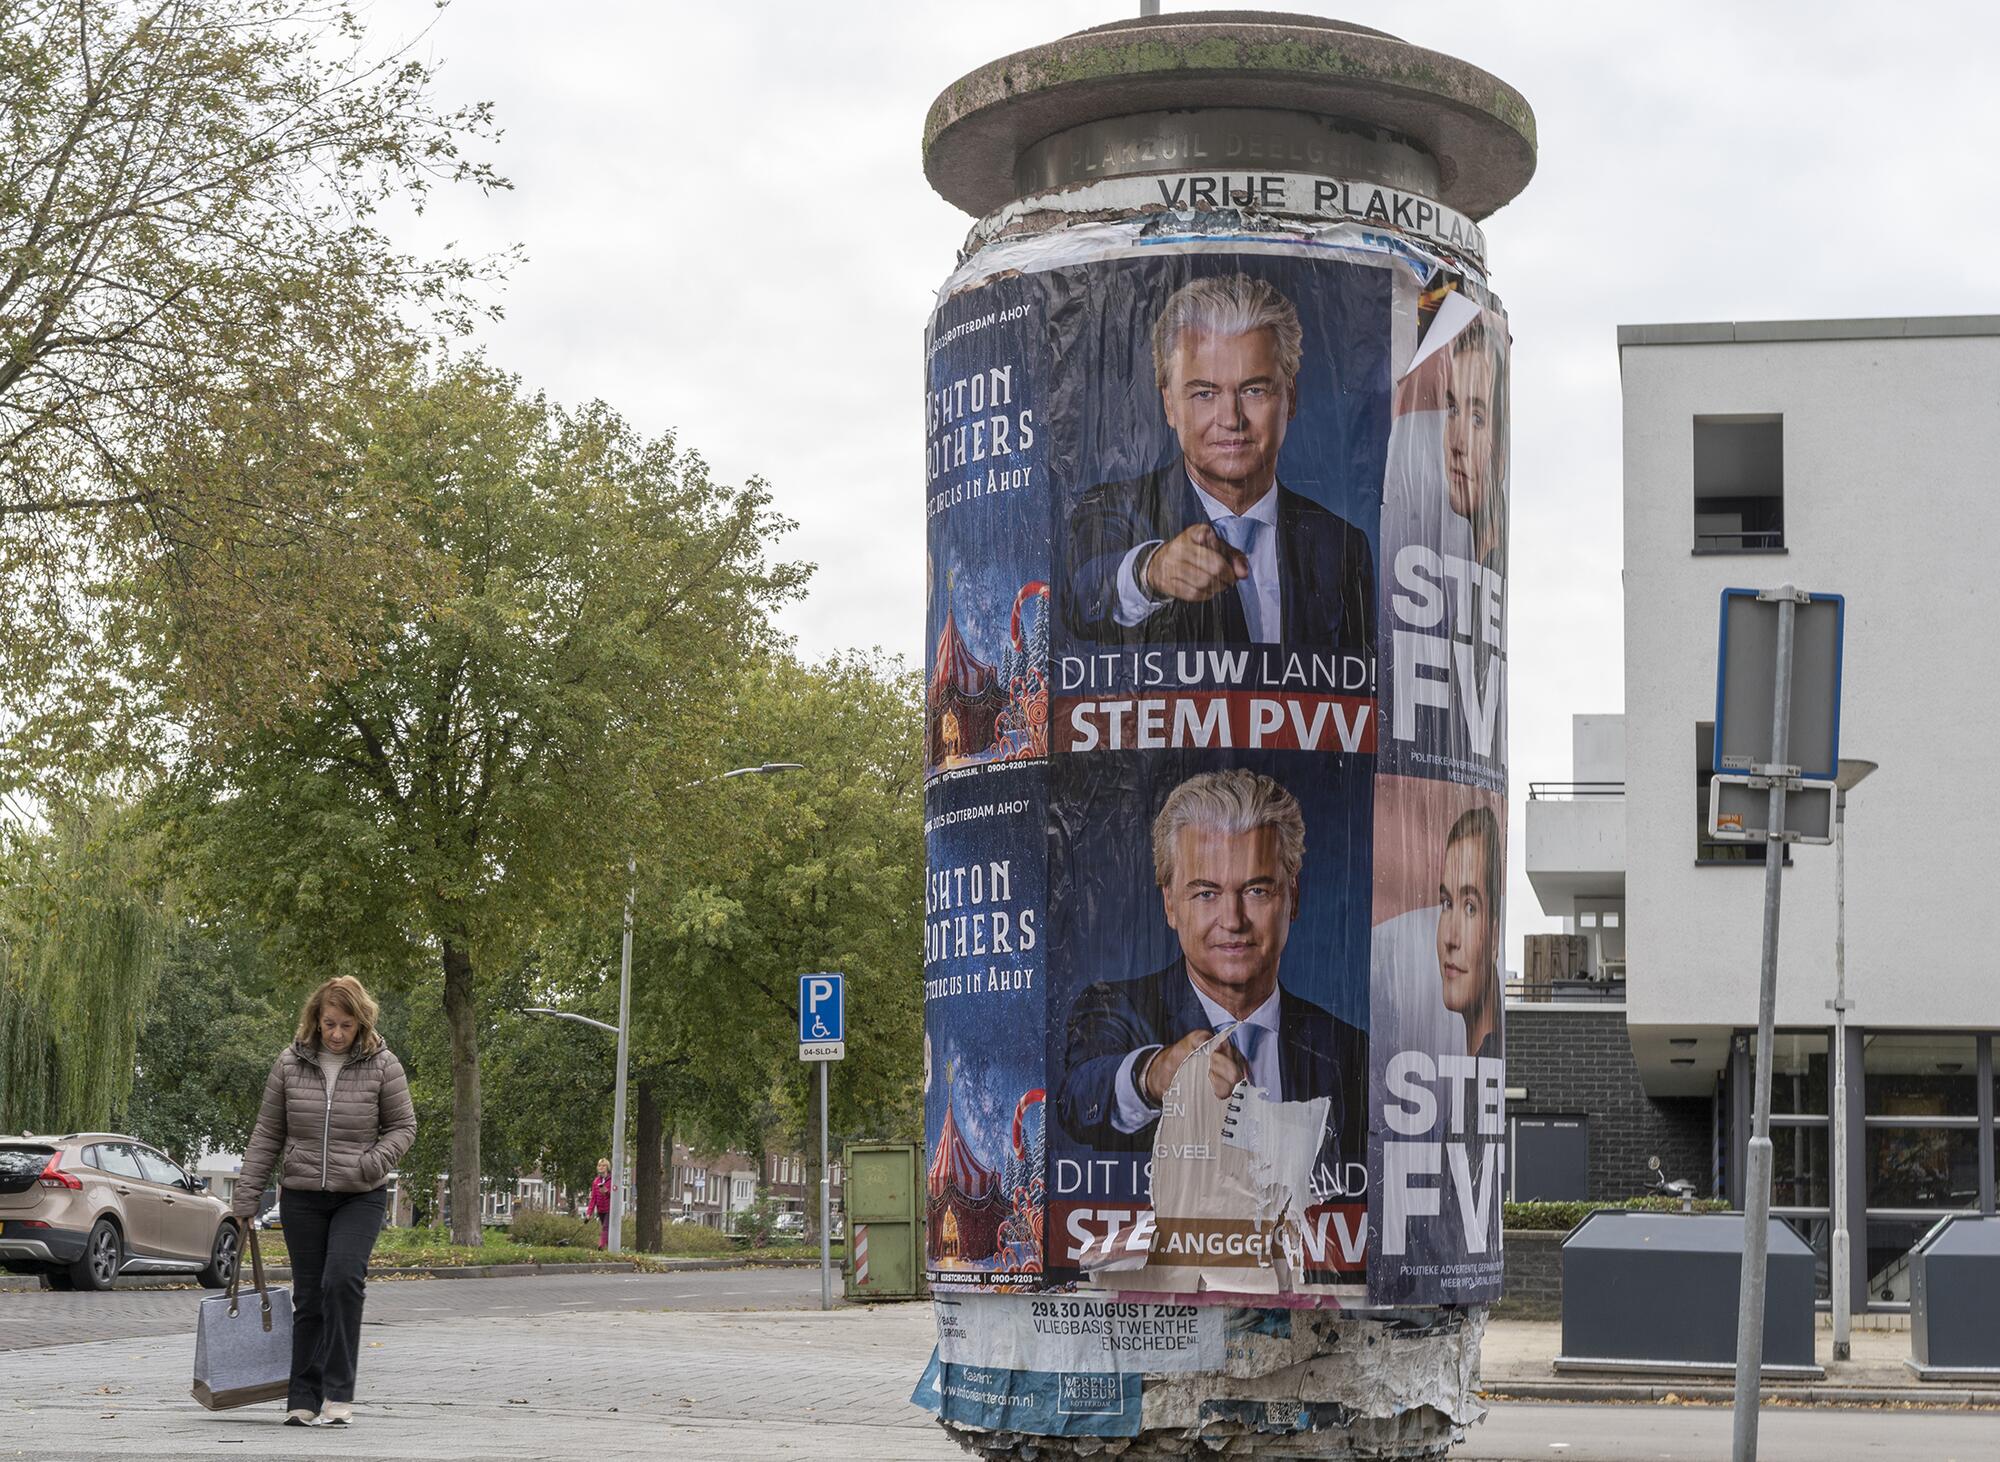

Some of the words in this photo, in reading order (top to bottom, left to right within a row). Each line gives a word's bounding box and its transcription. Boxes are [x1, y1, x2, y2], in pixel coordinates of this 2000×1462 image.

[1157, 175, 1286, 210] VRIJE
[947, 313, 995, 341] ROTTERDAM
[999, 304, 1031, 322] AHOY
[967, 479, 981, 500] IN
[986, 466, 1033, 494] AHOY
[1392, 544, 1506, 653] STE
[1062, 654, 1121, 690] DIT
[1133, 651, 1164, 685] IS
[1177, 650, 1249, 684] UW
[1263, 651, 1377, 692] LAND!
[1392, 629, 1507, 765] FV
[1071, 698, 1233, 752] STEM
[1250, 699, 1371, 752] PVV
[987, 761, 1027, 773] 0900-9203
[945, 805, 994, 825] ROTTERDAM
[997, 800, 1030, 815] AHOY
[967, 973, 981, 993] IN
[988, 966, 1034, 991] AHOY
[809, 980, 832, 1013] P
[1172, 1144, 1217, 1160] VEEL
[1057, 1158, 1119, 1195] DIT
[1382, 1141, 1505, 1255] FV
[990, 1274, 1033, 1283] 0900-9203
[1400, 1263, 1440, 1276] POLITIEKE
[1440, 1278, 1461, 1289] MEER
[1084, 1302, 1149, 1318] AUGUST
[1154, 1304, 1198, 1318] 2025
[1034, 1319, 1113, 1335] VLIEGBASIS
[1118, 1320, 1199, 1336] TWENTHE
[1064, 1376, 1116, 1389] WERELD
[1064, 1387, 1116, 1400] MUSEUM
[1070, 1400, 1111, 1408] ROTTERDAM
